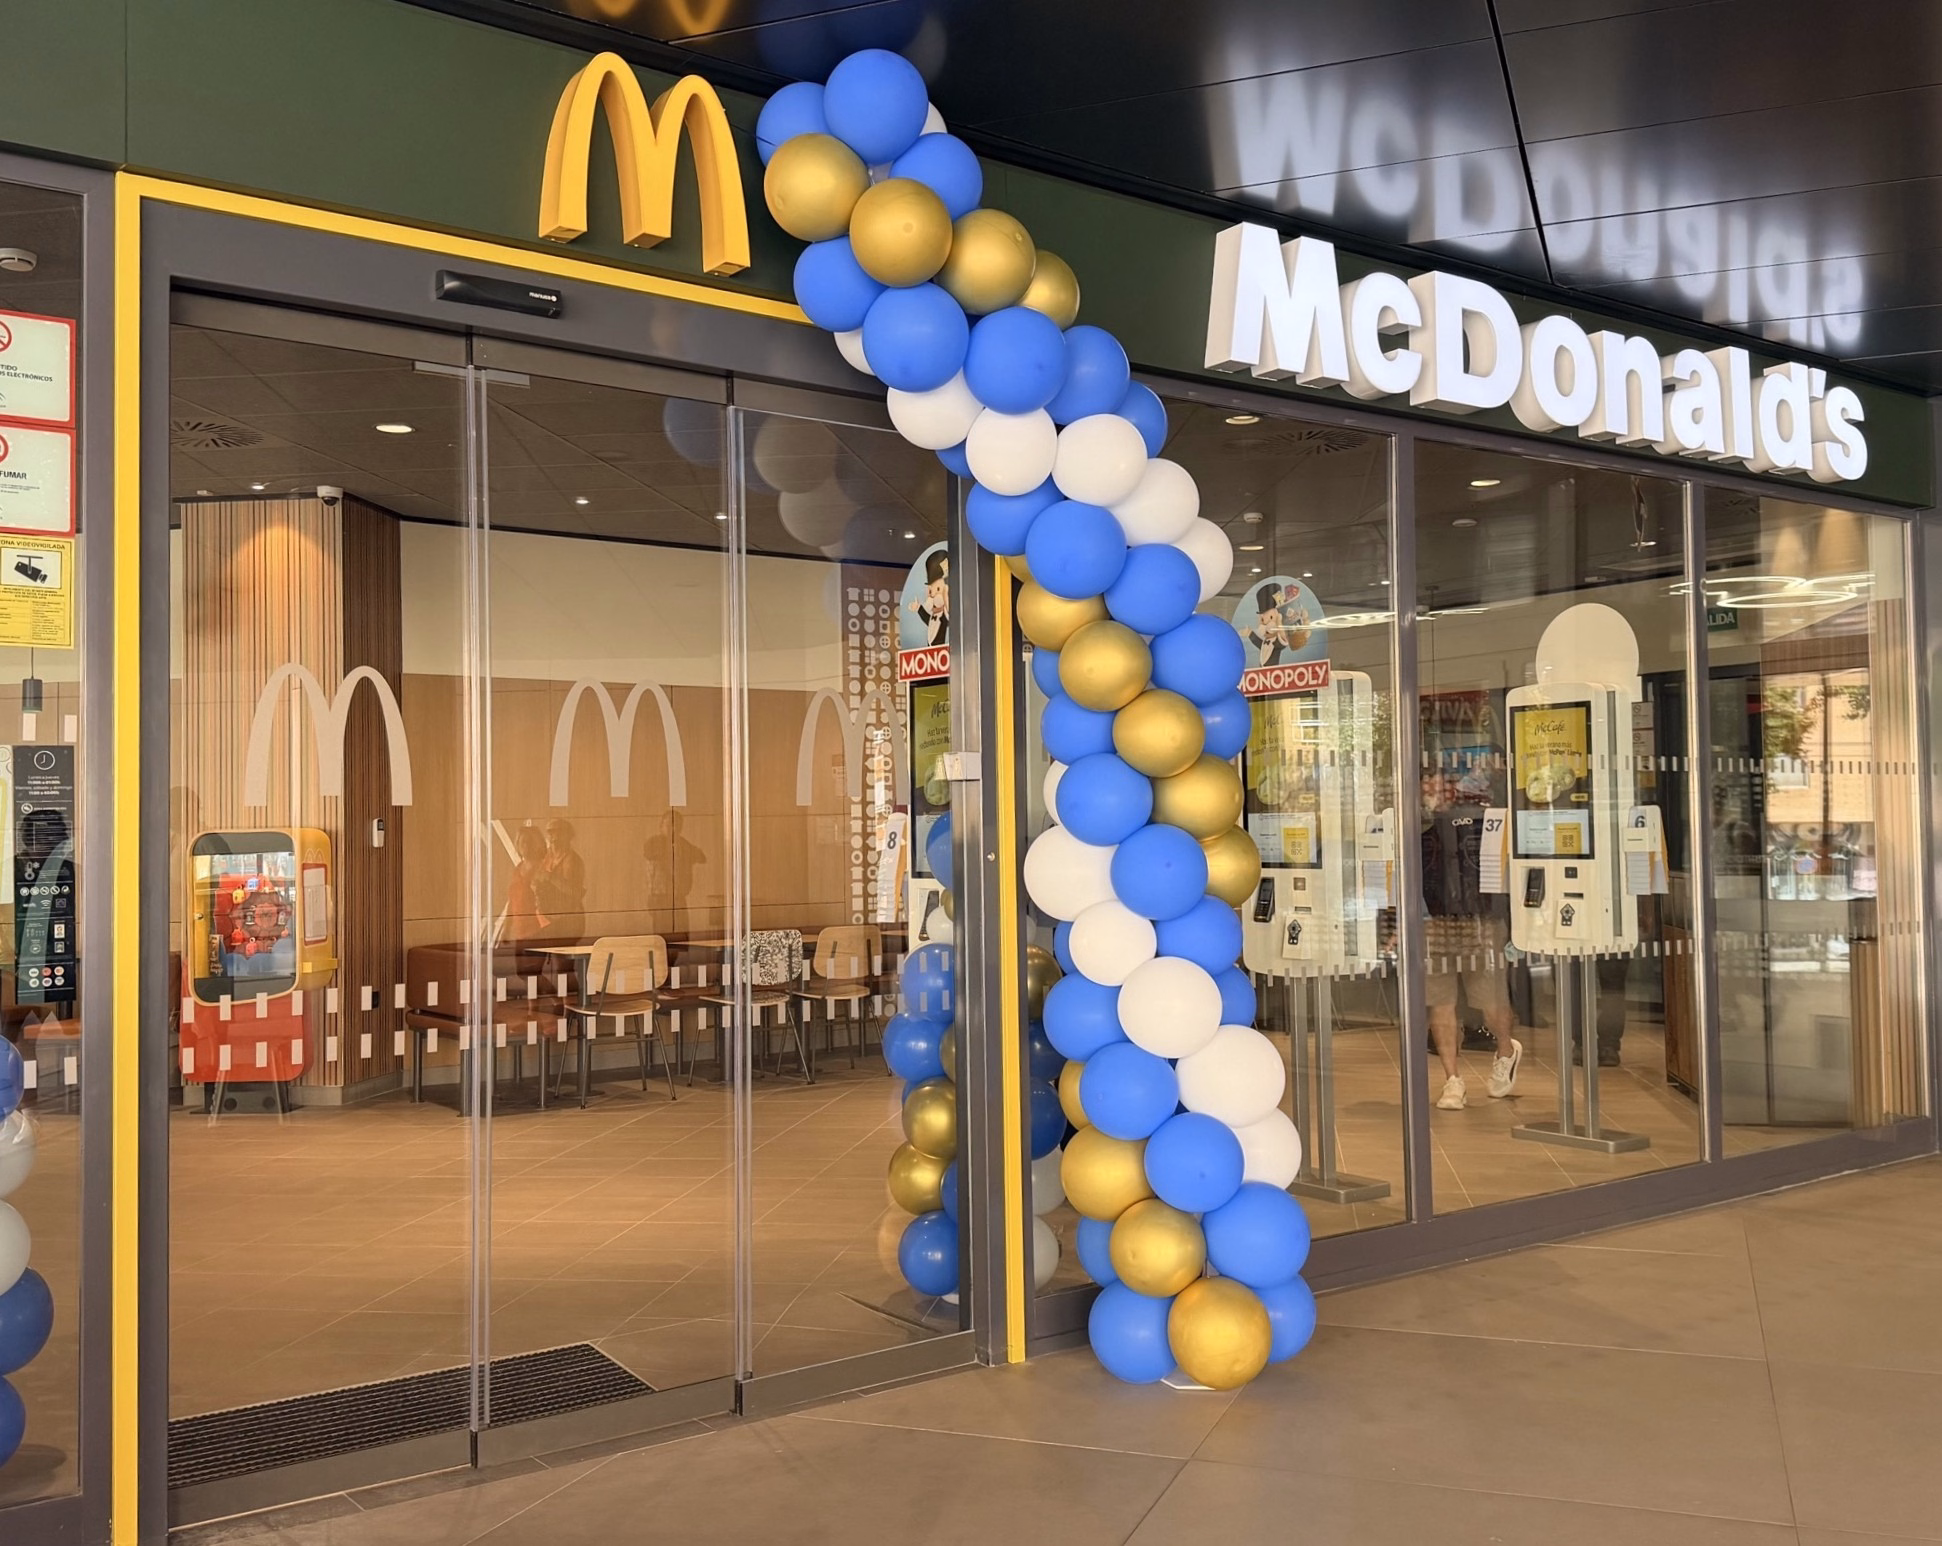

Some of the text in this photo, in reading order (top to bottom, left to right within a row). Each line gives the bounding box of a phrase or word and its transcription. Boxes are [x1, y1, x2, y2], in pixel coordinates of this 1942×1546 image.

[1204, 222, 1868, 483] McDonald's
[1707, 611, 1736, 626] LIDA
[1485, 818, 1503, 832] 37
[887, 831, 897, 850] 8
